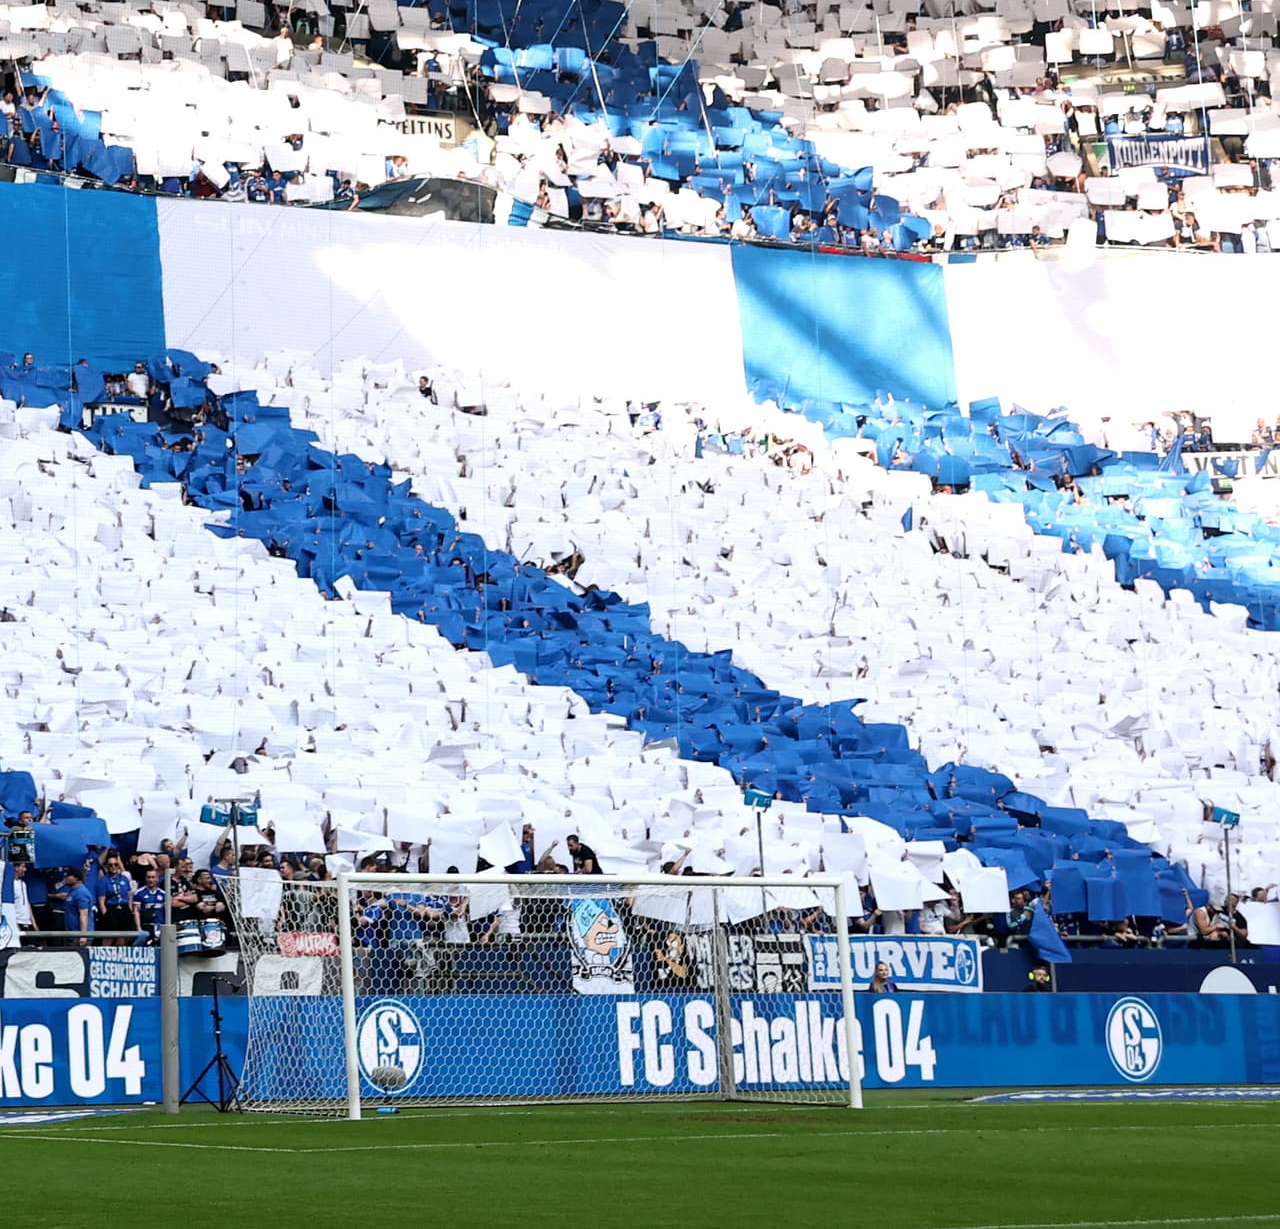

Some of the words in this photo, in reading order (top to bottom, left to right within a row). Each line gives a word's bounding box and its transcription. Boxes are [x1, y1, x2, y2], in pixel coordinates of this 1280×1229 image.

[1112, 137, 1205, 171] KOHLENPOTT
[89, 946, 155, 964] FUSSBALLCLUB
[825, 940, 956, 980] KURVE
[89, 963, 155, 982] GELSENKIRCHEN
[89, 979, 156, 998] SCHALKE
[68, 1002, 146, 1099] 04
[616, 999, 676, 1087] FC
[872, 998, 937, 1083] 04
